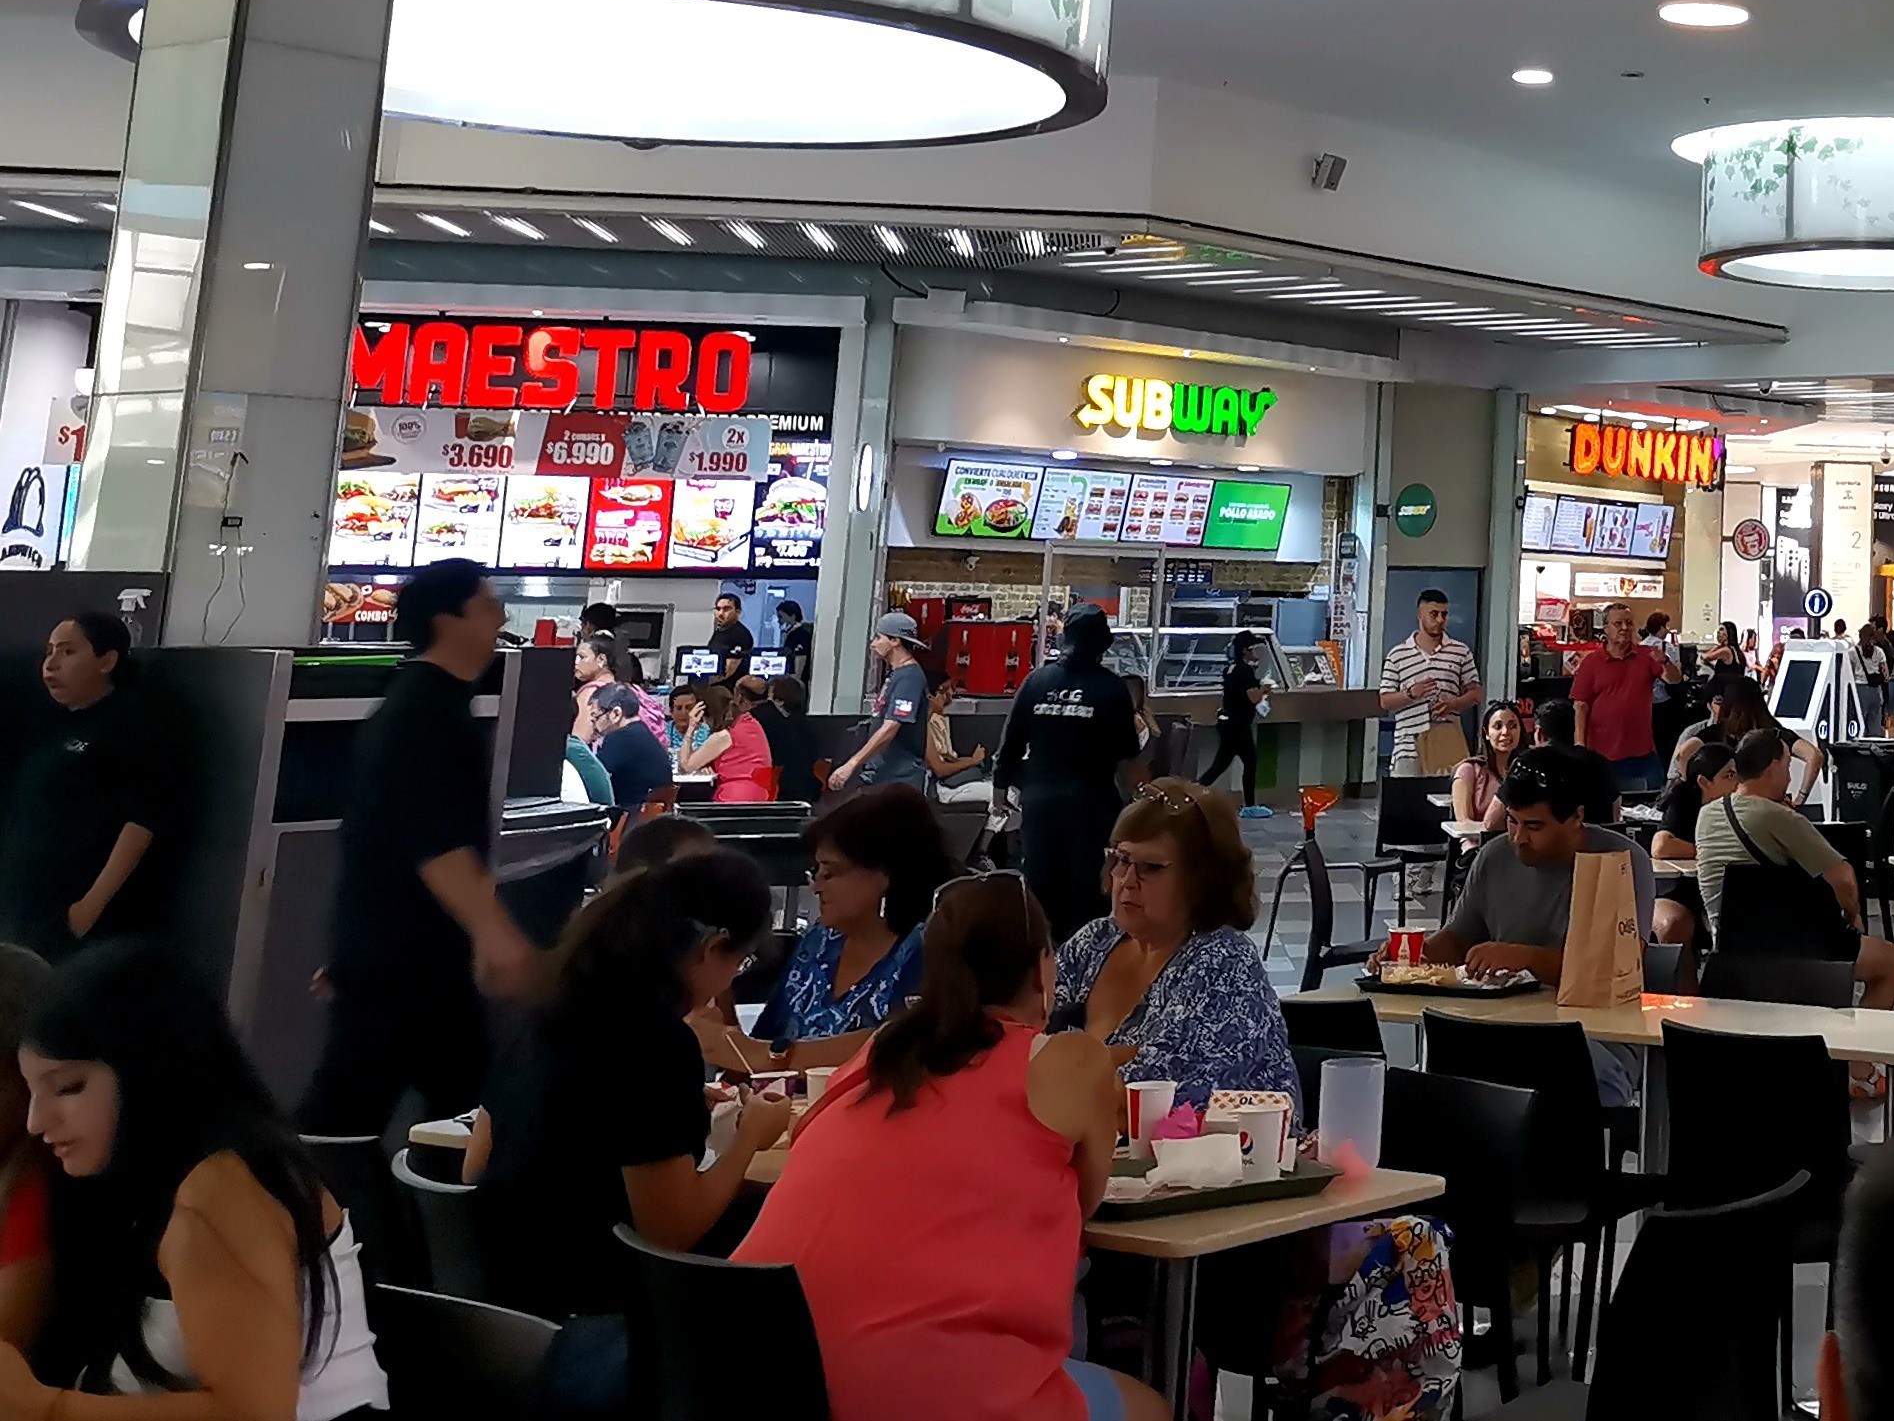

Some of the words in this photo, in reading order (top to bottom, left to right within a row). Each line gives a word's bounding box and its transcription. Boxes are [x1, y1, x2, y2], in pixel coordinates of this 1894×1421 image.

[352, 322, 752, 413] MAESTRO
[1077, 374, 1279, 437] SUBWAY
[441, 442, 514, 469] $3.690
[545, 441, 615, 466] $6.990
[688, 451, 748, 473] $1.990
[354, 610, 388, 622] COMBO
